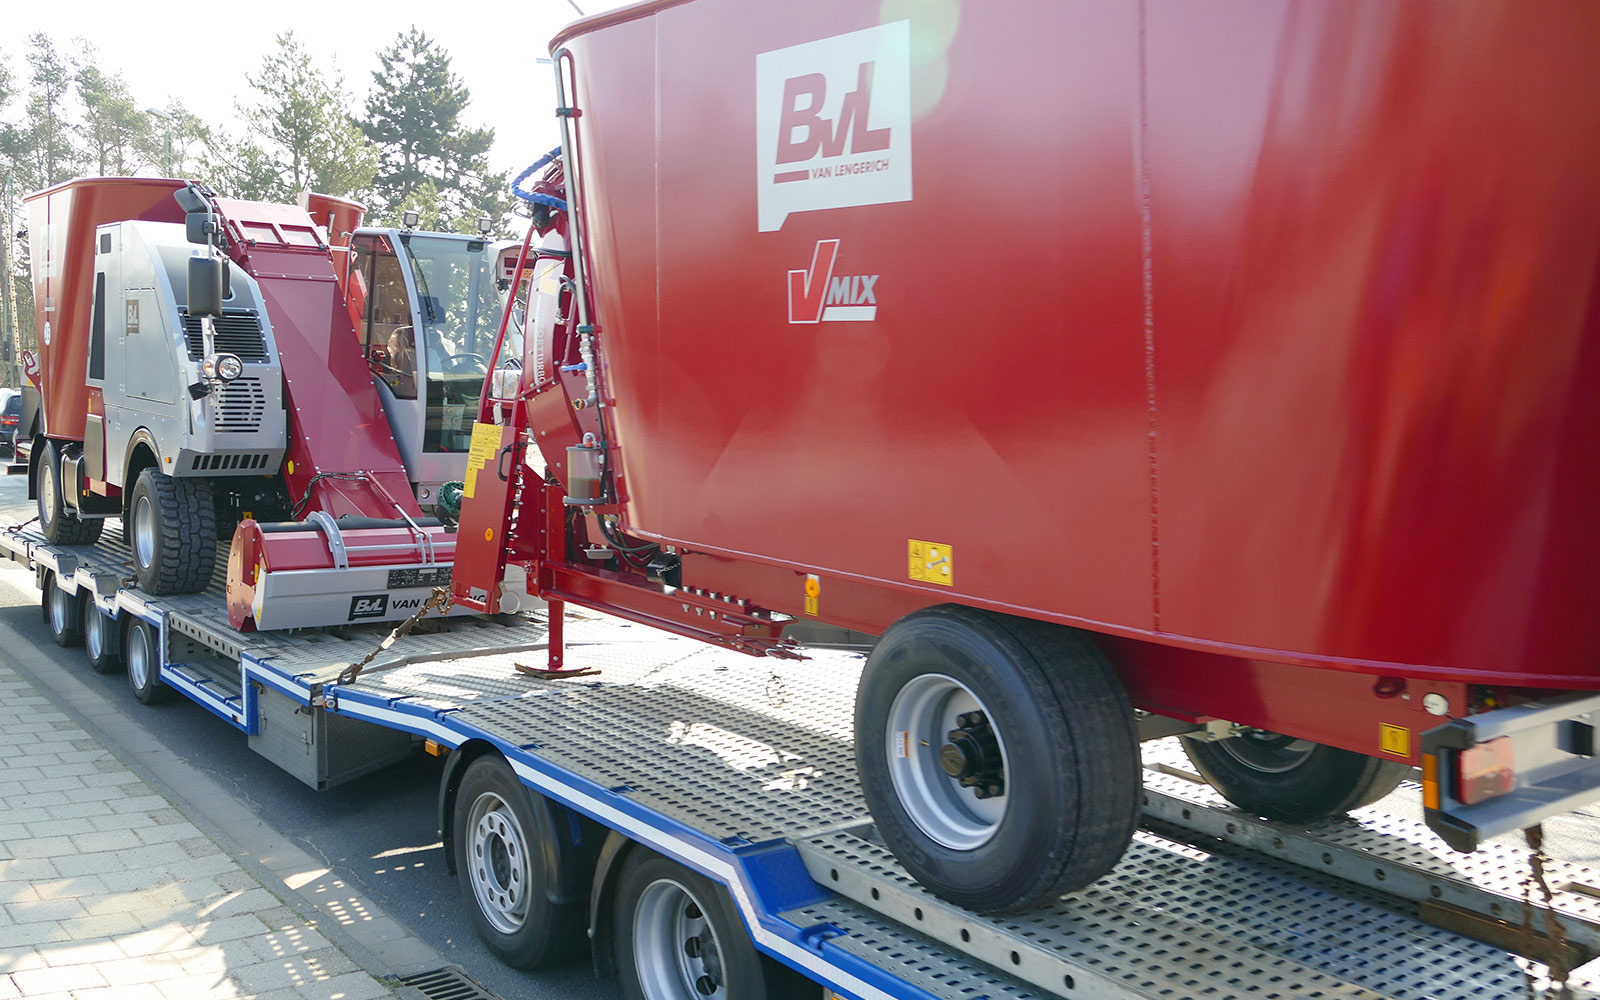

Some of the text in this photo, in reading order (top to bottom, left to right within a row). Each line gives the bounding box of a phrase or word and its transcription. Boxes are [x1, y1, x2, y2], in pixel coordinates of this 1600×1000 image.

[812, 159, 889, 179] VAN LENGERICH
[392, 599, 421, 609] VAN
